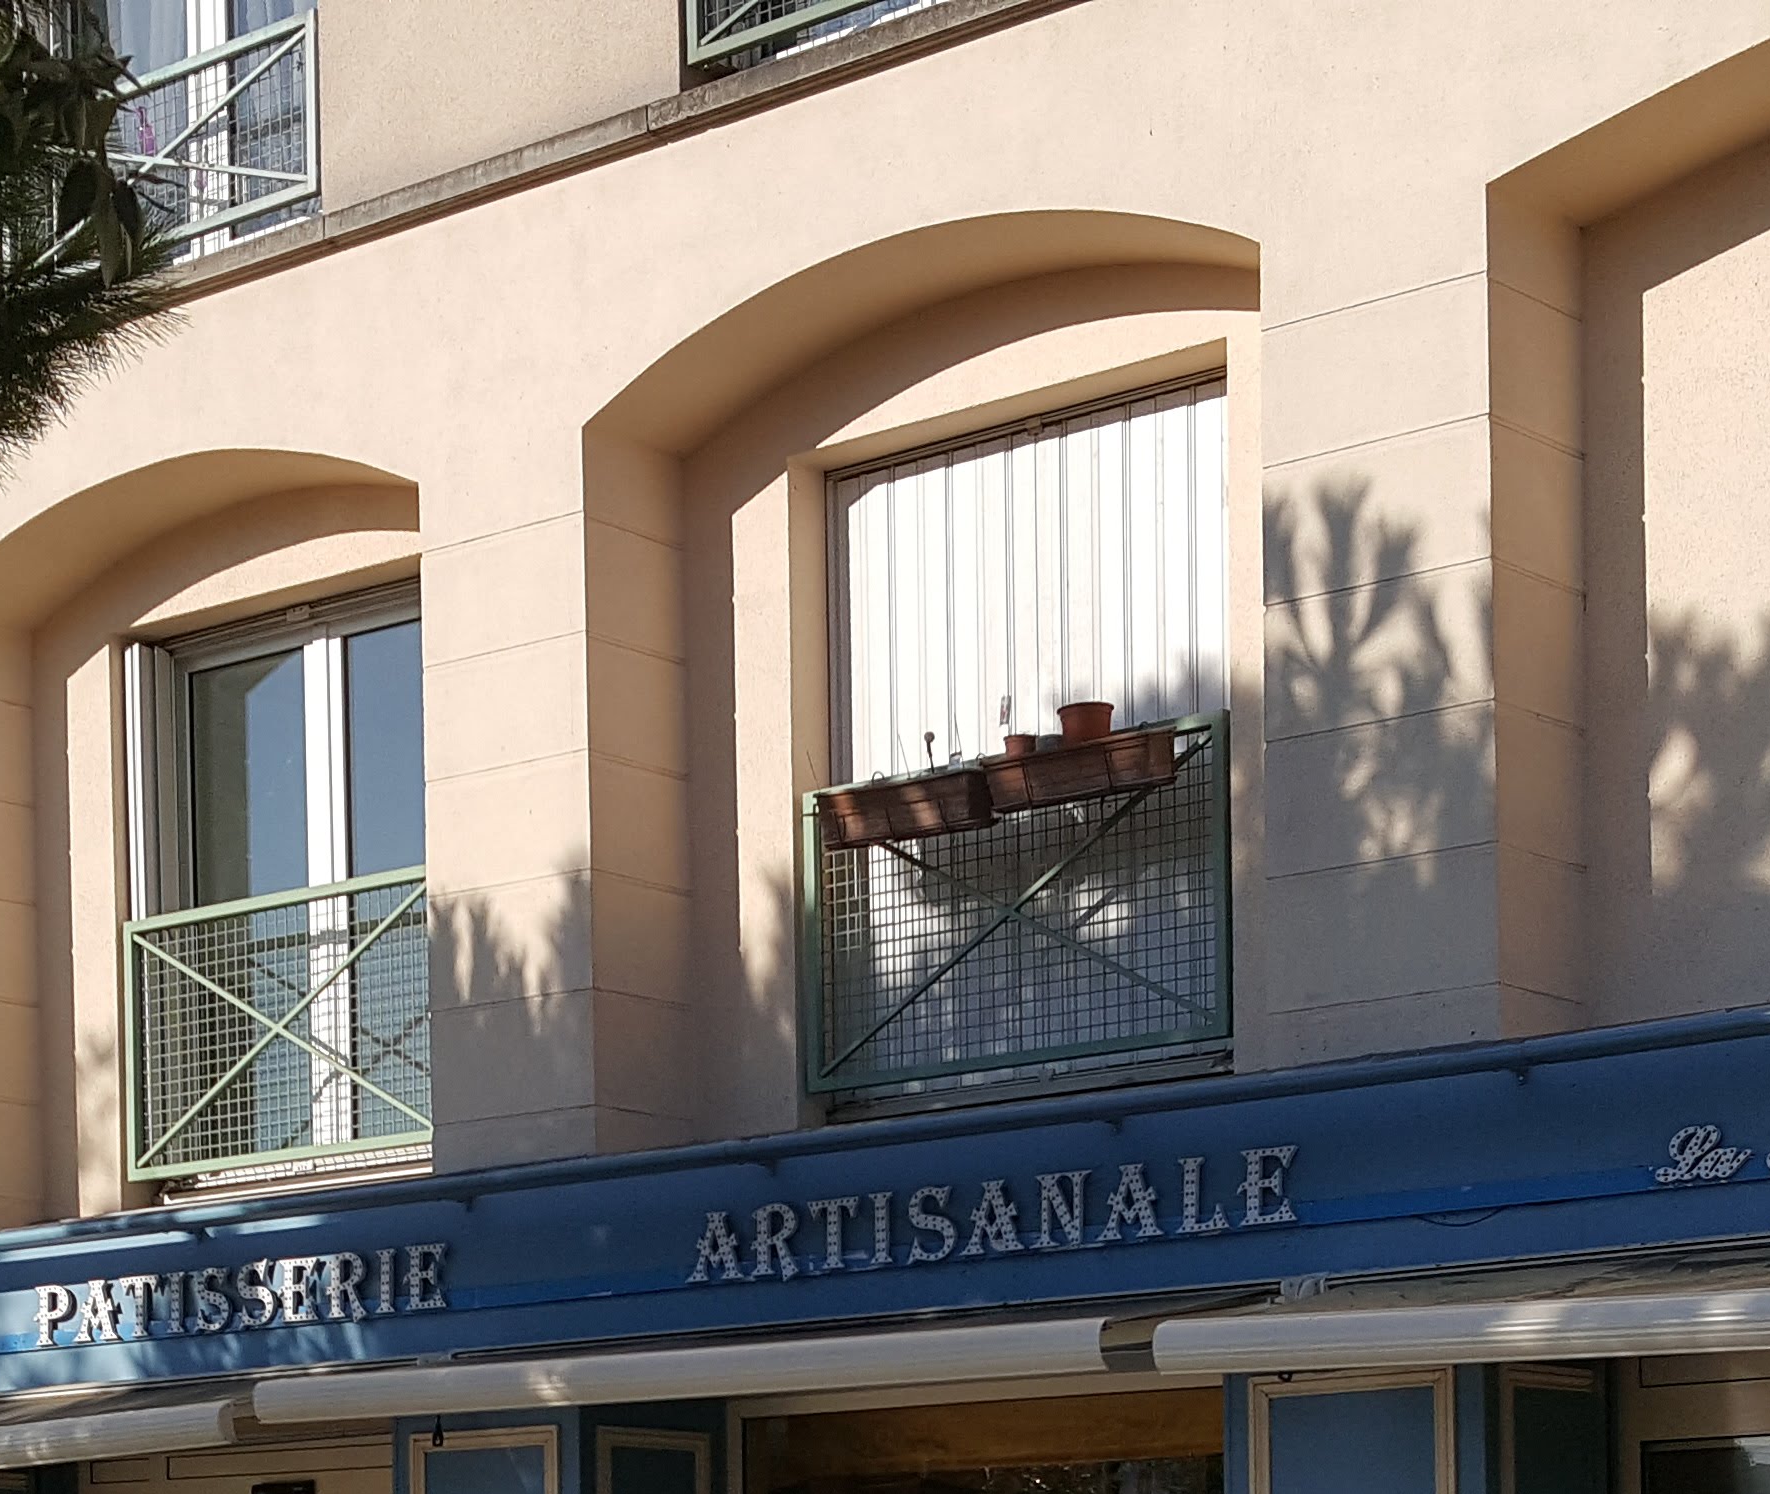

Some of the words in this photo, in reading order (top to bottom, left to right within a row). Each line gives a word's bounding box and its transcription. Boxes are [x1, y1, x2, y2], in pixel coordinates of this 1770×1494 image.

[1655, 1124, 1751, 1184] La
[33, 1243, 450, 1348] PATISSERIE
[685, 1145, 1299, 1283] ARTISANALE
